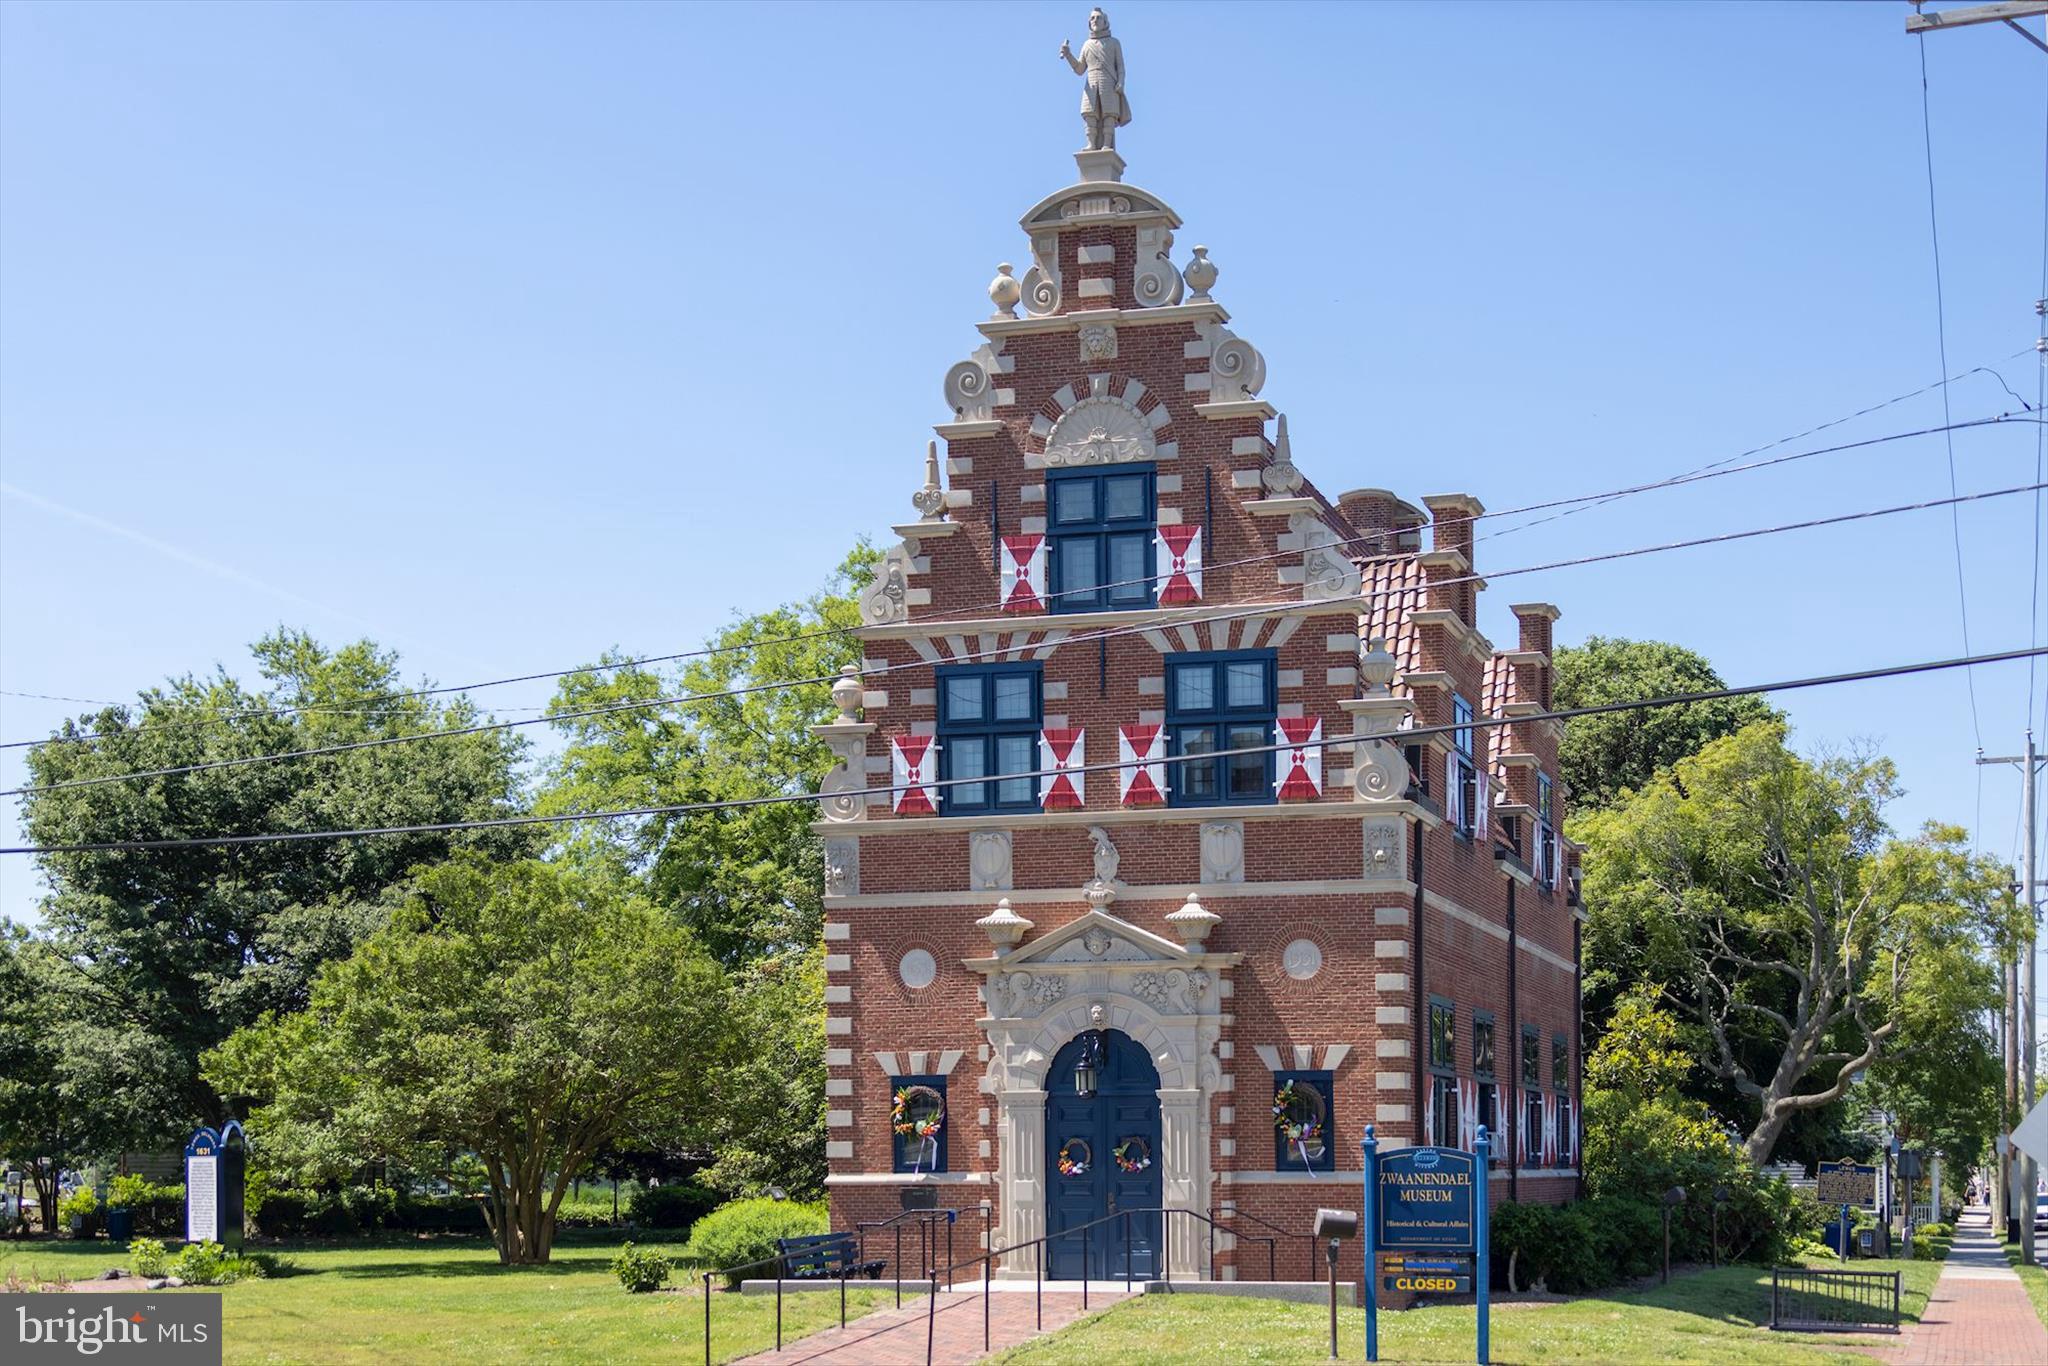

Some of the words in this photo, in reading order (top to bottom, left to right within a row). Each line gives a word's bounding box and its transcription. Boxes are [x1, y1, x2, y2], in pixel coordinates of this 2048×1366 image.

[196, 1147, 210, 1155] 1631
[1379, 1172, 1472, 1185] ZWAANENDAEL
[1400, 1189, 1452, 1202] MUSEUM
[1386, 1220, 1415, 1228] Historical
[1416, 1220, 1422, 1228] &
[1423, 1220, 1448, 1228] Cultural
[1449, 1220, 1469, 1228] Affairs
[1396, 1277, 1457, 1291] CLOSED
